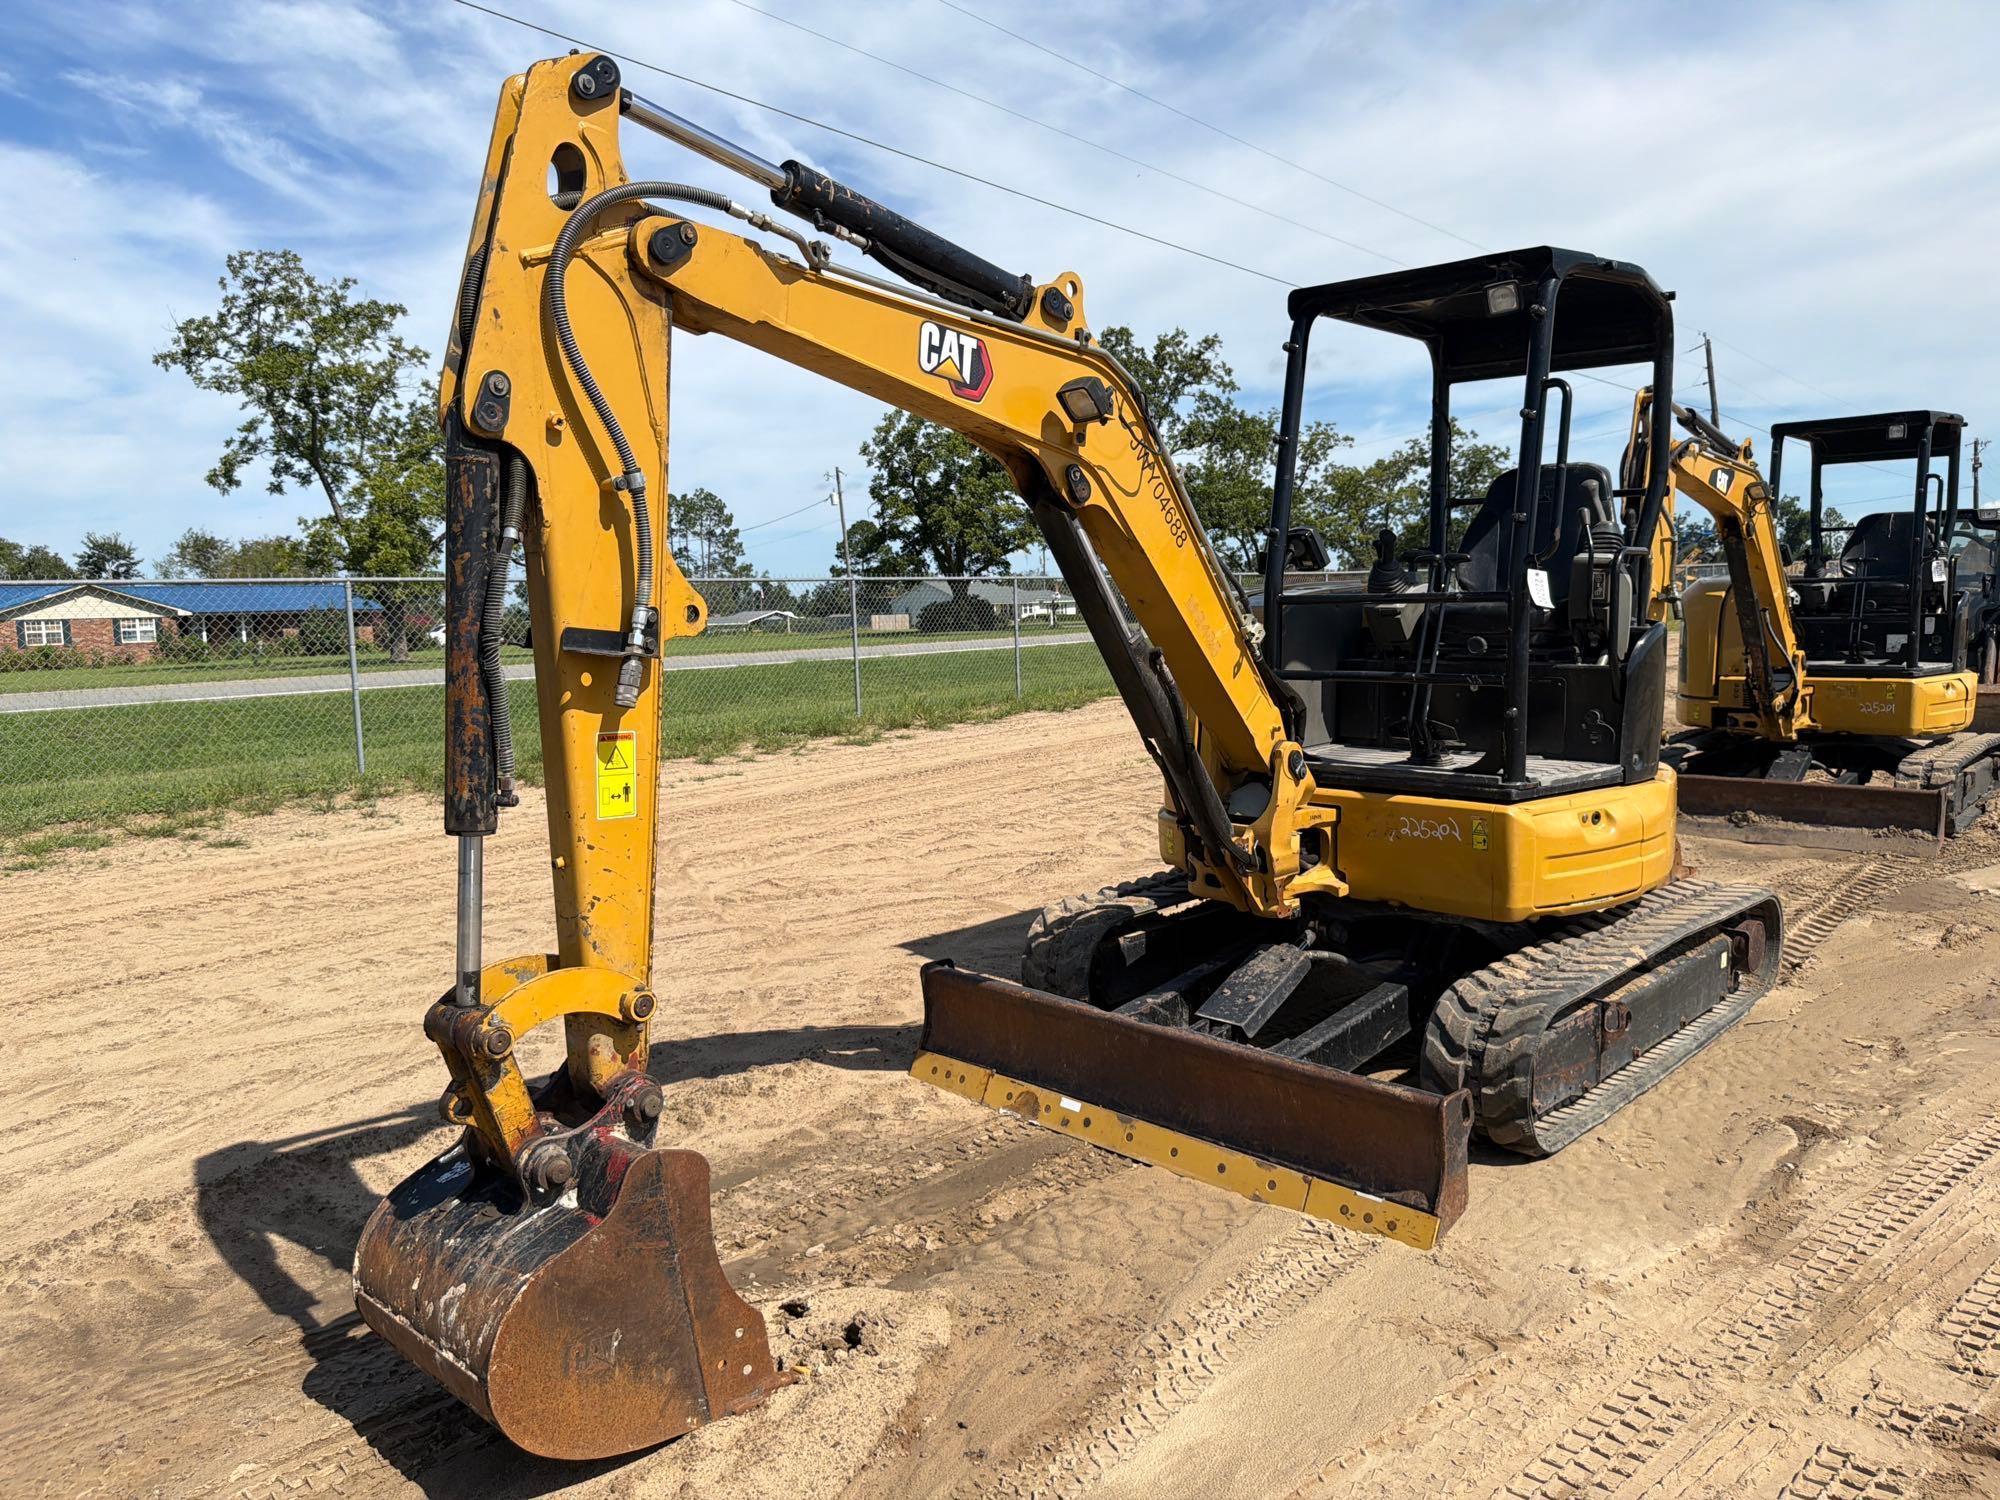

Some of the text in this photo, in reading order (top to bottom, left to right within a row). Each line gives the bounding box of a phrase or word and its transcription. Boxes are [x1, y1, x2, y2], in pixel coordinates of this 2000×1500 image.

[919, 322, 978, 384] CAT
[1859, 701, 1895, 715] 225201
[1400, 816, 1462, 841] 225202
